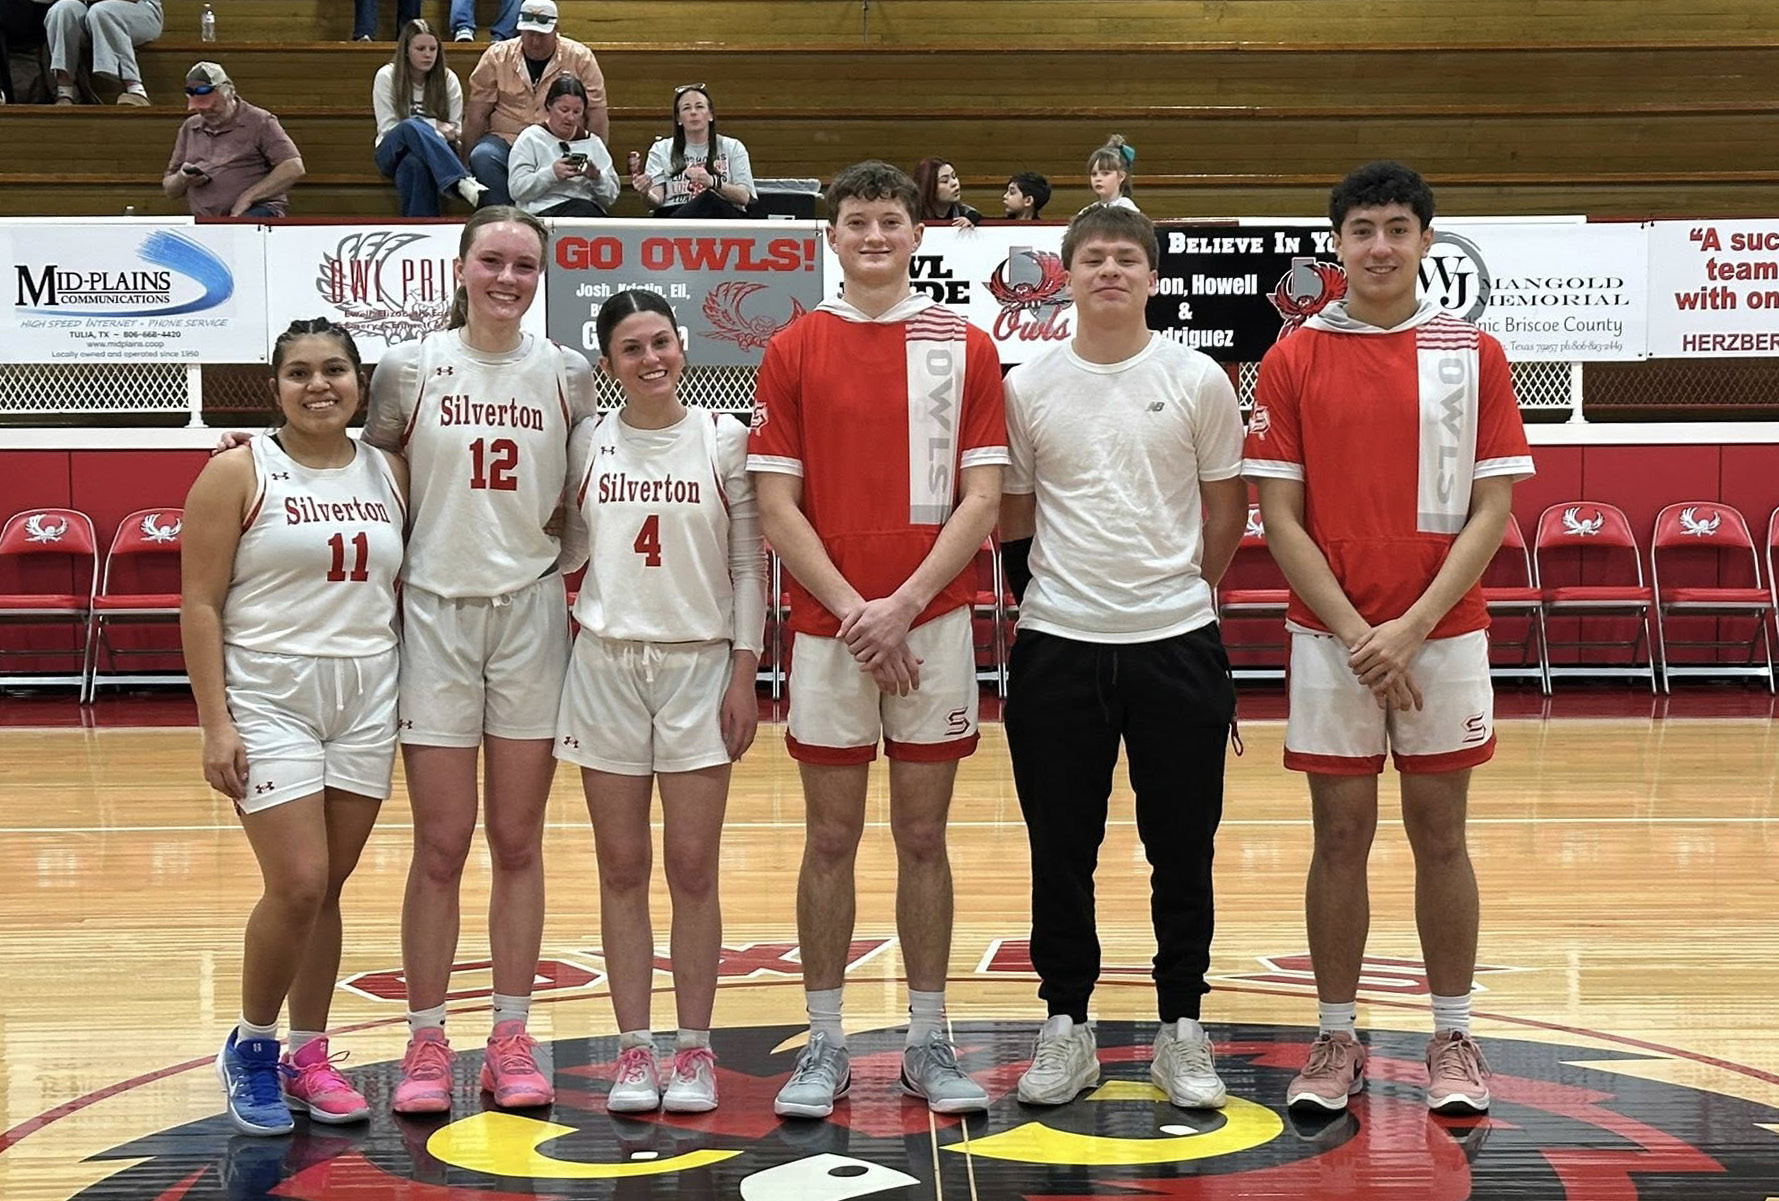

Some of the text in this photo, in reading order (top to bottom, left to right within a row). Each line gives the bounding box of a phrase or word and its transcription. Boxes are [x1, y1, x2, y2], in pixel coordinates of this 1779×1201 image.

[555, 236, 816, 272] GO OWLS!
[1706, 257, 1778, 280] team
[330, 259, 386, 303] OWL
[1192, 275, 1258, 295] Howell
[1481, 277, 1624, 290] MANGOLD
[61, 294, 170, 304] COMMUNICATIONS
[1475, 294, 1630, 307] MEMORIAL
[1674, 286, 1737, 310] with
[20, 320, 46, 328] HIGH
[48, 319, 82, 328] SPEED
[86, 317, 137, 328] INTERNET
[148, 319, 182, 328] PHONE
[185, 318, 229, 327] SERVICE
[993, 304, 1071, 341] Owls
[1178, 302, 1193, 320] &
[69, 331, 97, 339] TULIA,
[1505, 316, 1559, 332] Briscoe
[1563, 315, 1623, 337] County
[51, 350, 79, 359] Locally
[106, 350, 123, 358] and
[124, 350, 158, 360] operated
[160, 350, 179, 358] since
[1511, 341, 1534, 351] Texas
[439, 395, 544, 431] Silverton
[926, 349, 952, 495] OWLS
[1437, 357, 1466, 504] OWLS
[469, 438, 518, 491] 12
[598, 472, 701, 504] Silverton
[284, 496, 391, 526] Silverton
[633, 514, 662, 567] 4
[326, 531, 370, 582] 11
